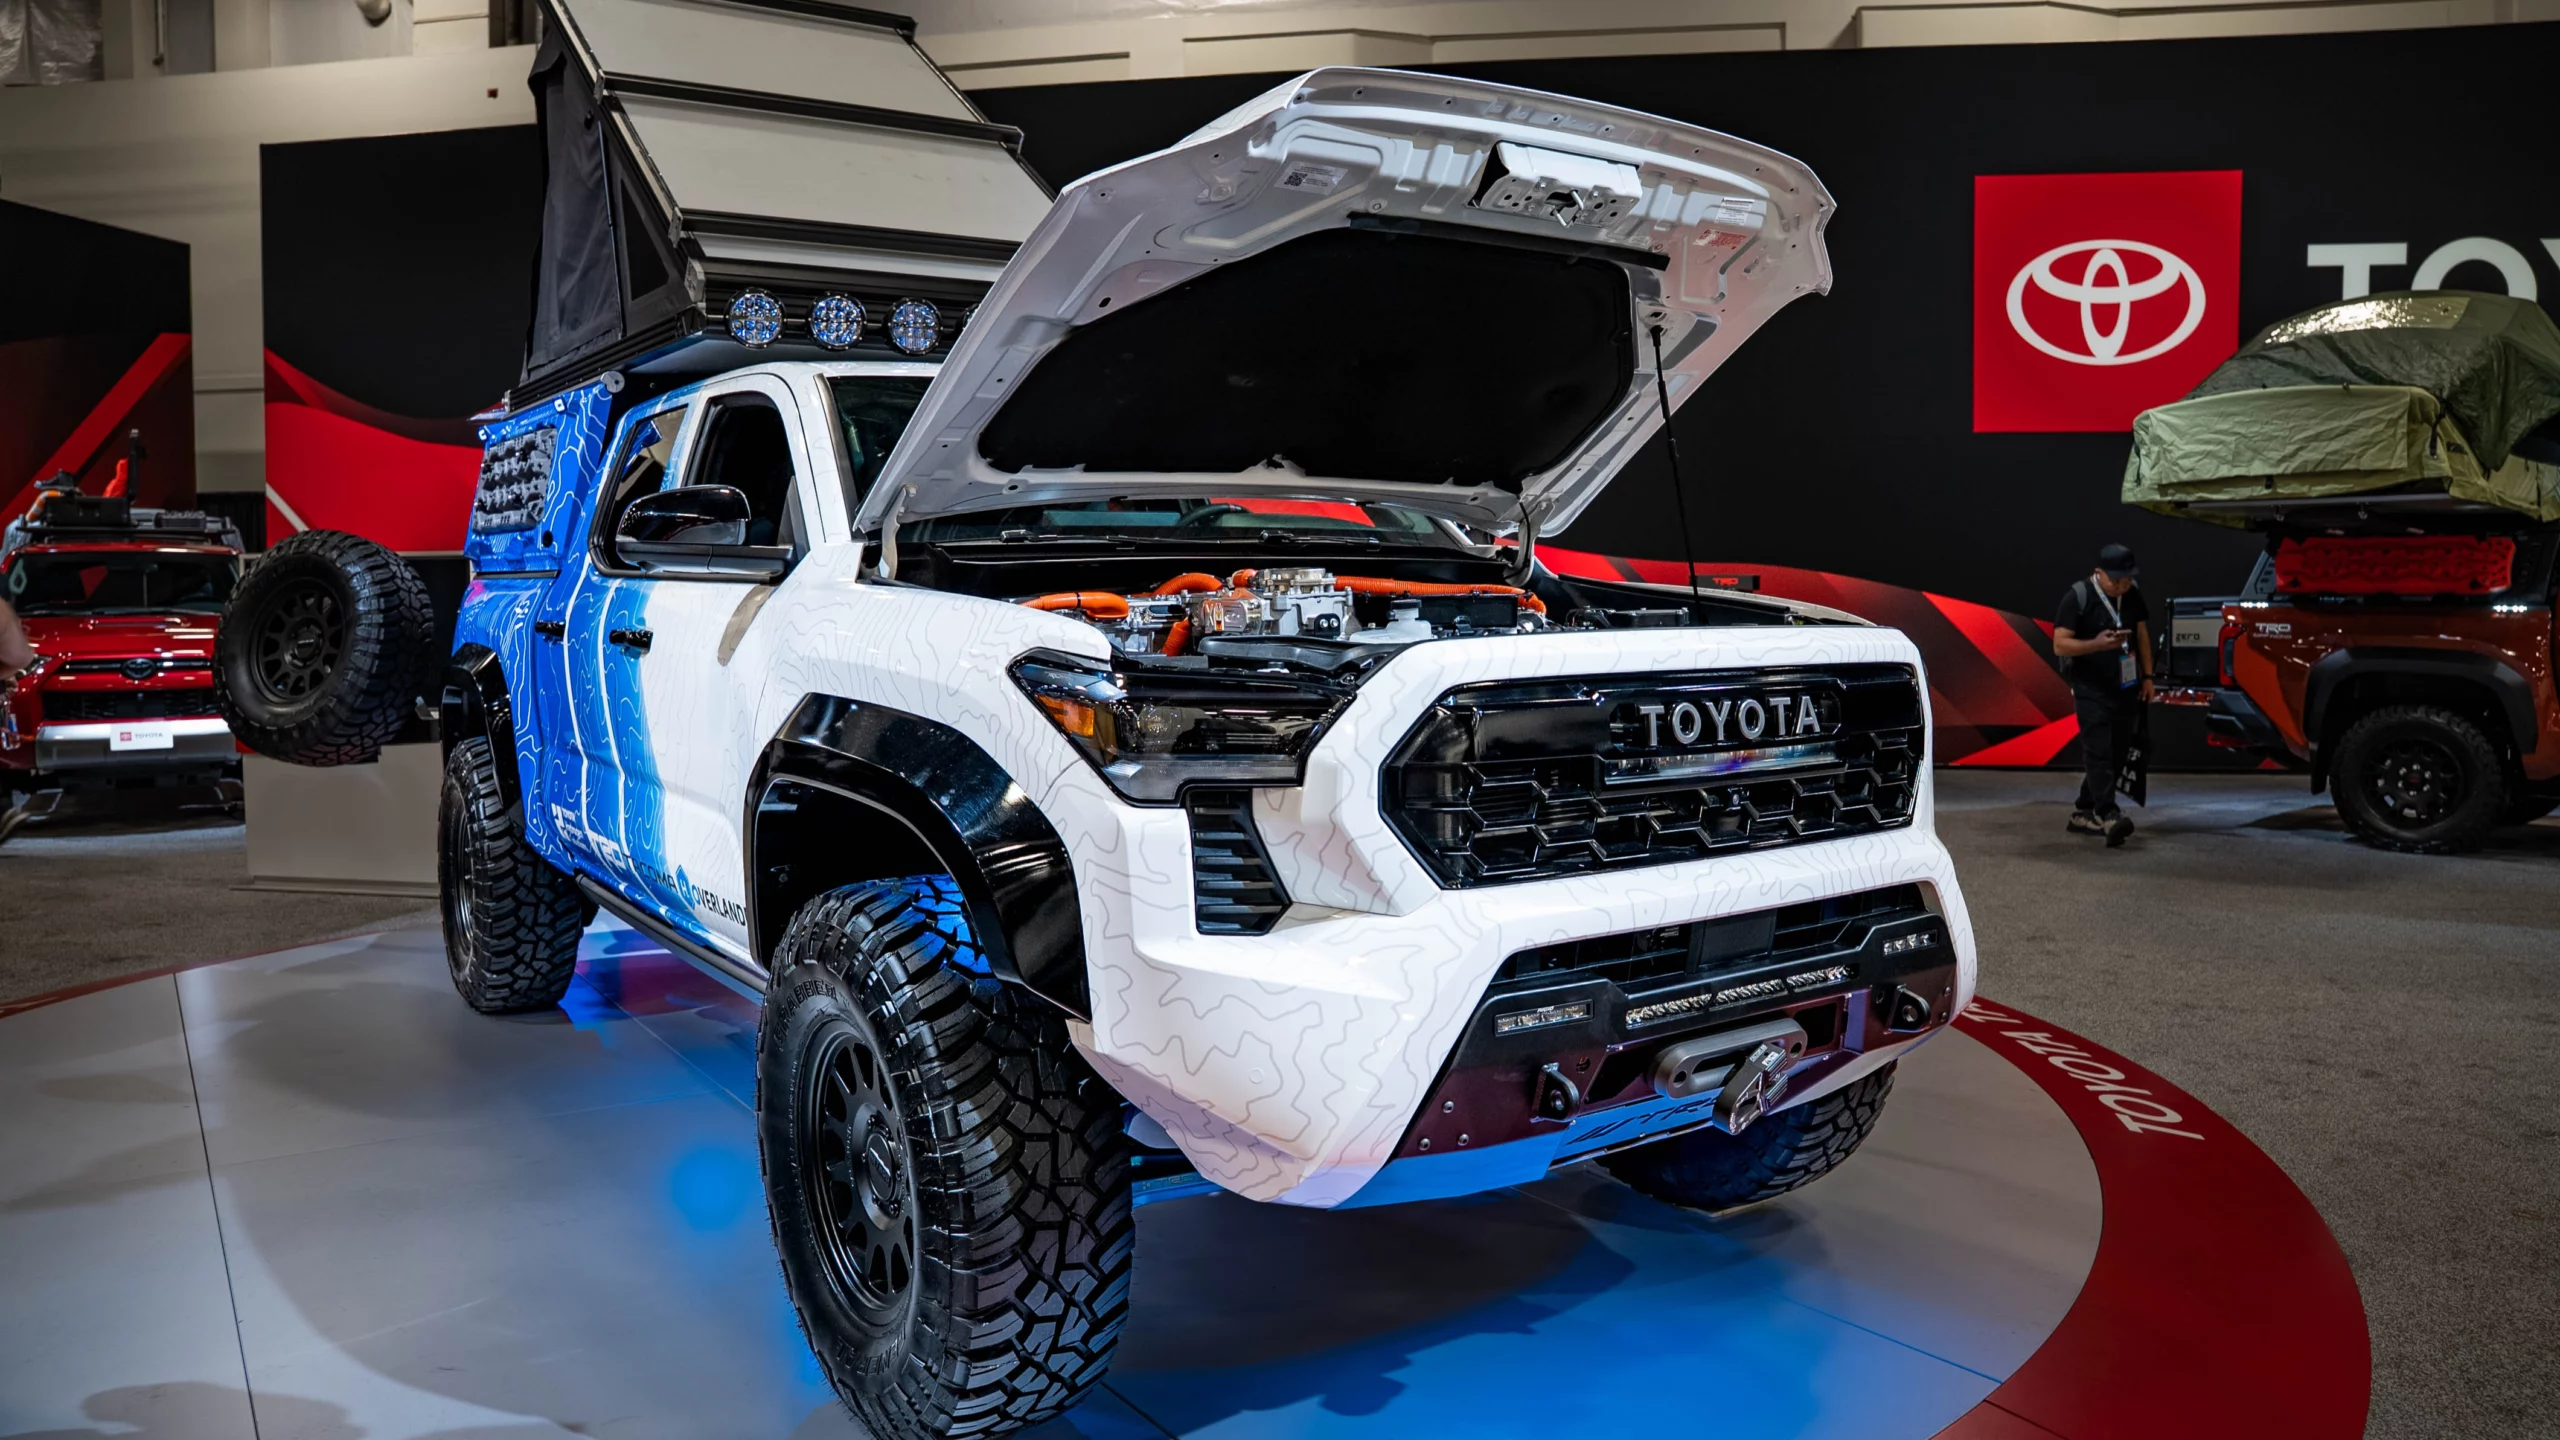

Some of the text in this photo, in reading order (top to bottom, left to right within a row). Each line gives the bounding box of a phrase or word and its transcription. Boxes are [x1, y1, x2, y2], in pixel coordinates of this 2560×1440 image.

[2307, 236, 2560, 300] TO
[1639, 696, 1821, 746] TOYOTA
[622, 852, 679, 893] TACOMA
[691, 884, 746, 926] OVERLAND
[774, 979, 838, 1051] GRABBER
[2000, 1031, 2205, 1140] TOYOTA
